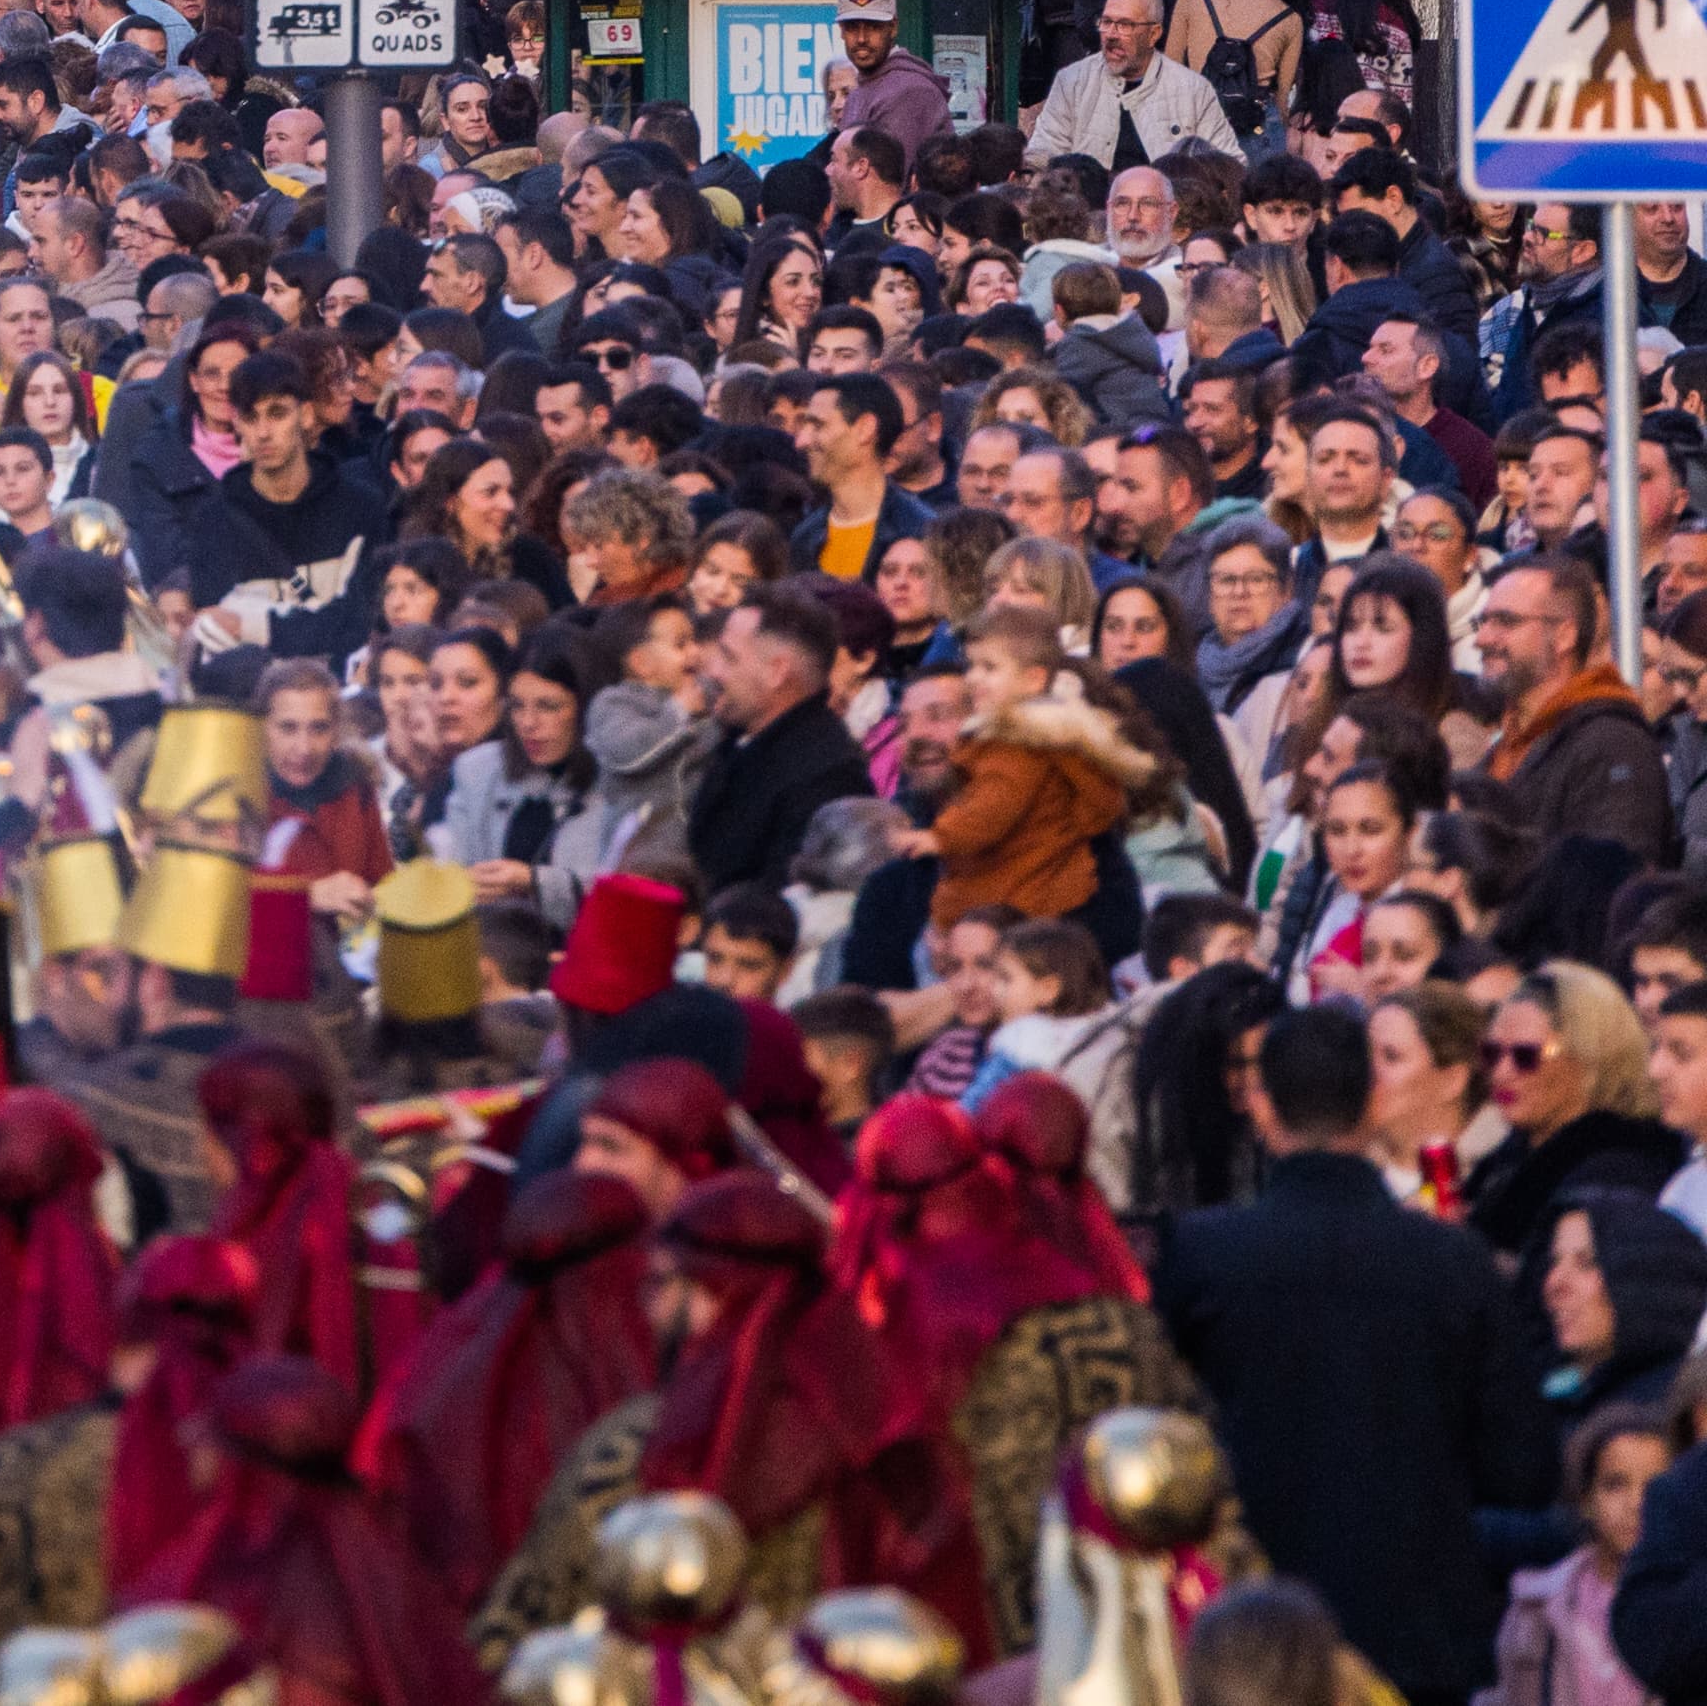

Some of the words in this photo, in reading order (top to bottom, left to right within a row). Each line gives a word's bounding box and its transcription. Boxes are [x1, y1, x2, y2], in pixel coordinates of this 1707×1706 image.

[372, 34, 443, 52] QUADS
[607, 24, 633, 43] 69
[729, 22, 845, 95] BIEN
[730, 94, 827, 137] JUGAD
